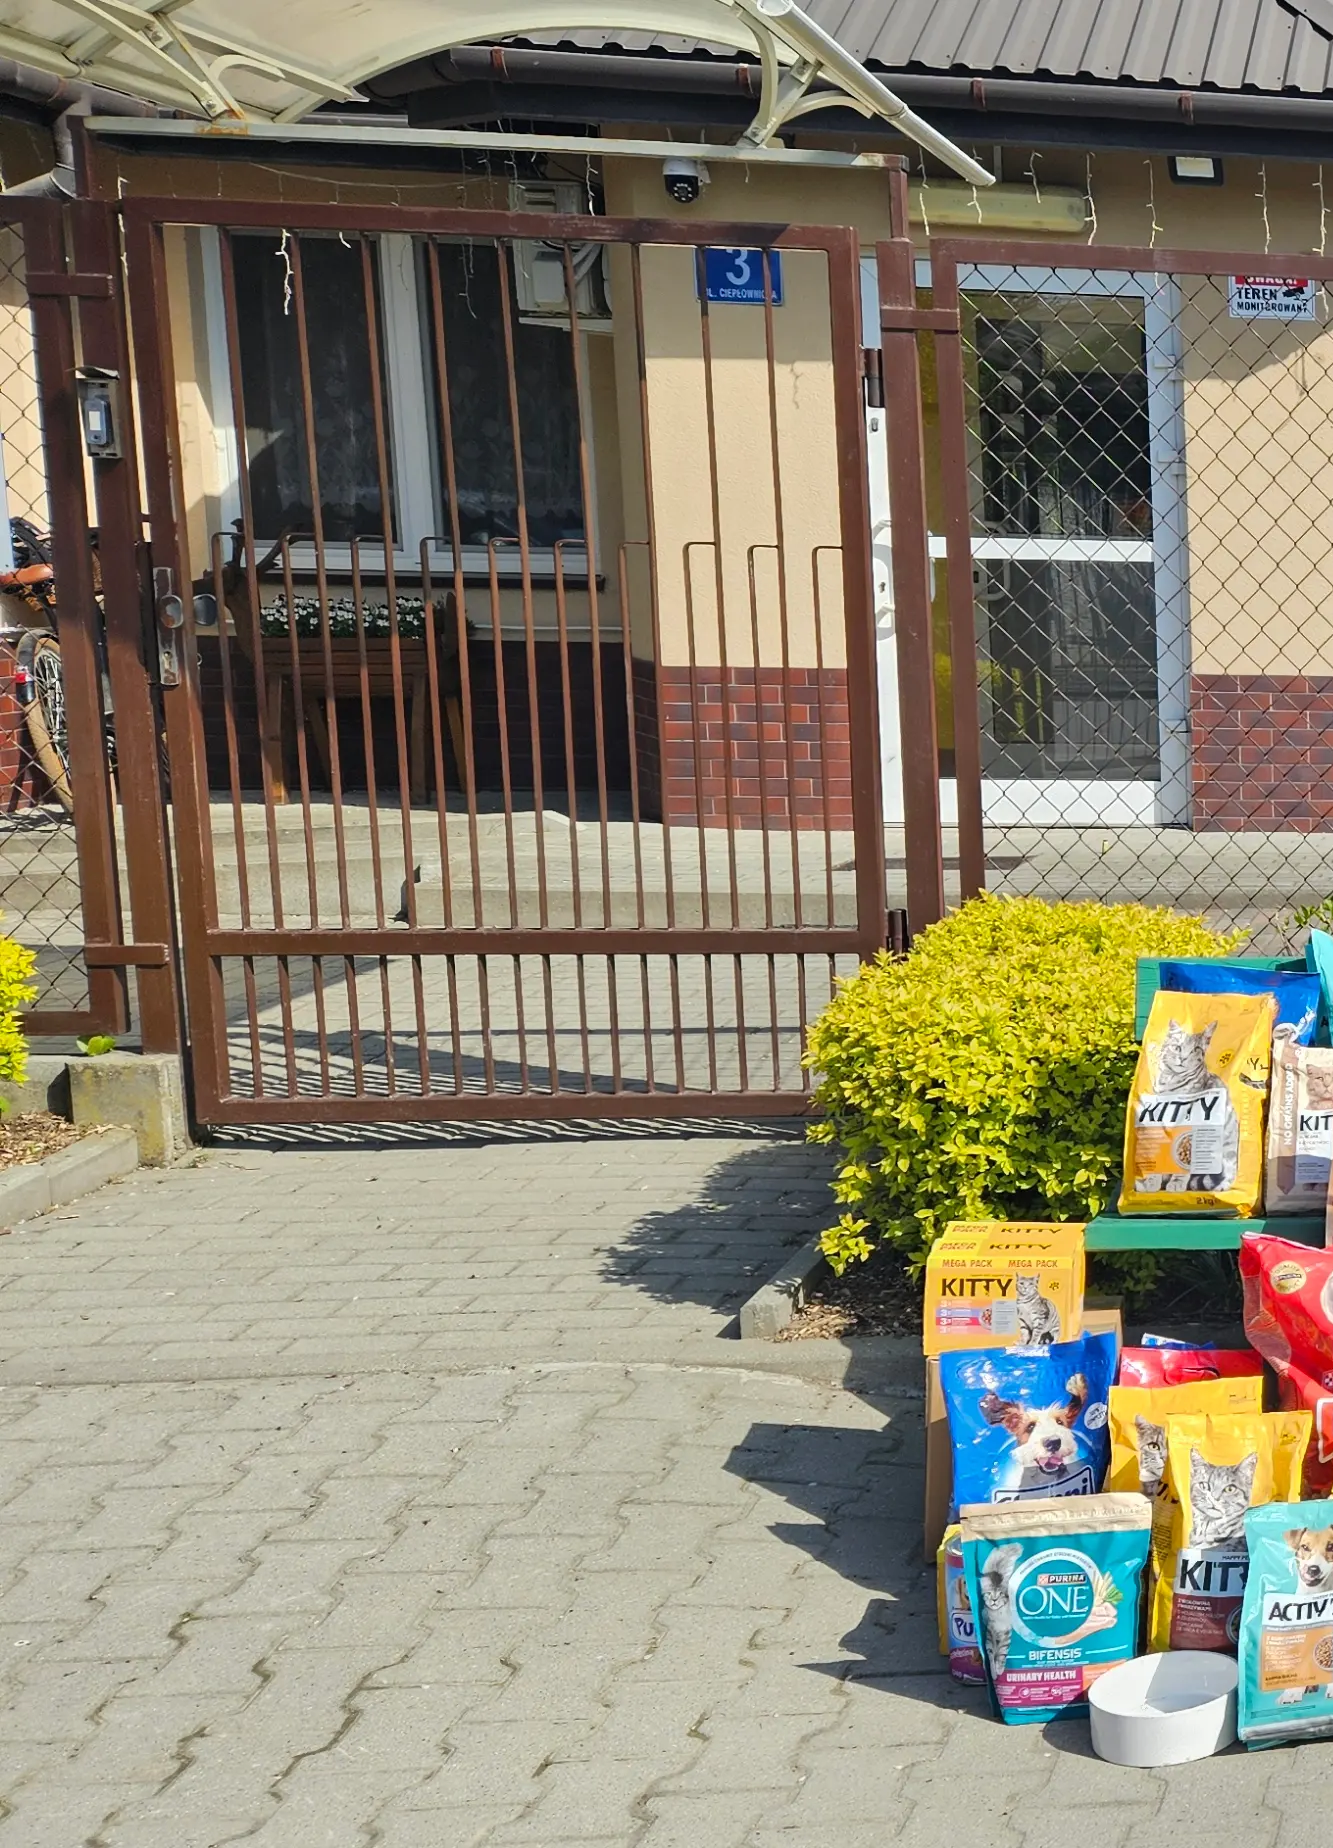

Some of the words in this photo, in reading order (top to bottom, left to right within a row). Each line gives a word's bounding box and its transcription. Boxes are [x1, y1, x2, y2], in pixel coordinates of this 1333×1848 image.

[726, 249, 751, 286] 3
[1237, 286, 1278, 301] TEREN
[1139, 1095, 1219, 1123] KITTY
[942, 1259, 967, 1268] MEGA
[970, 1259, 993, 1268] PACK
[1008, 1259, 1032, 1268] MEGA
[1035, 1259, 1058, 1268] PACK
[941, 1277, 1013, 1298] KITTY
[1049, 1573, 1085, 1584] PURINA
[1019, 1585, 1090, 1616] ONE
[1268, 1598, 1329, 1622] ACTIV
[1028, 1648, 1082, 1661] BIFENSIS
[1006, 1671, 1042, 1682] URINARY
[1043, 1670, 1077, 1681] HEALTH
